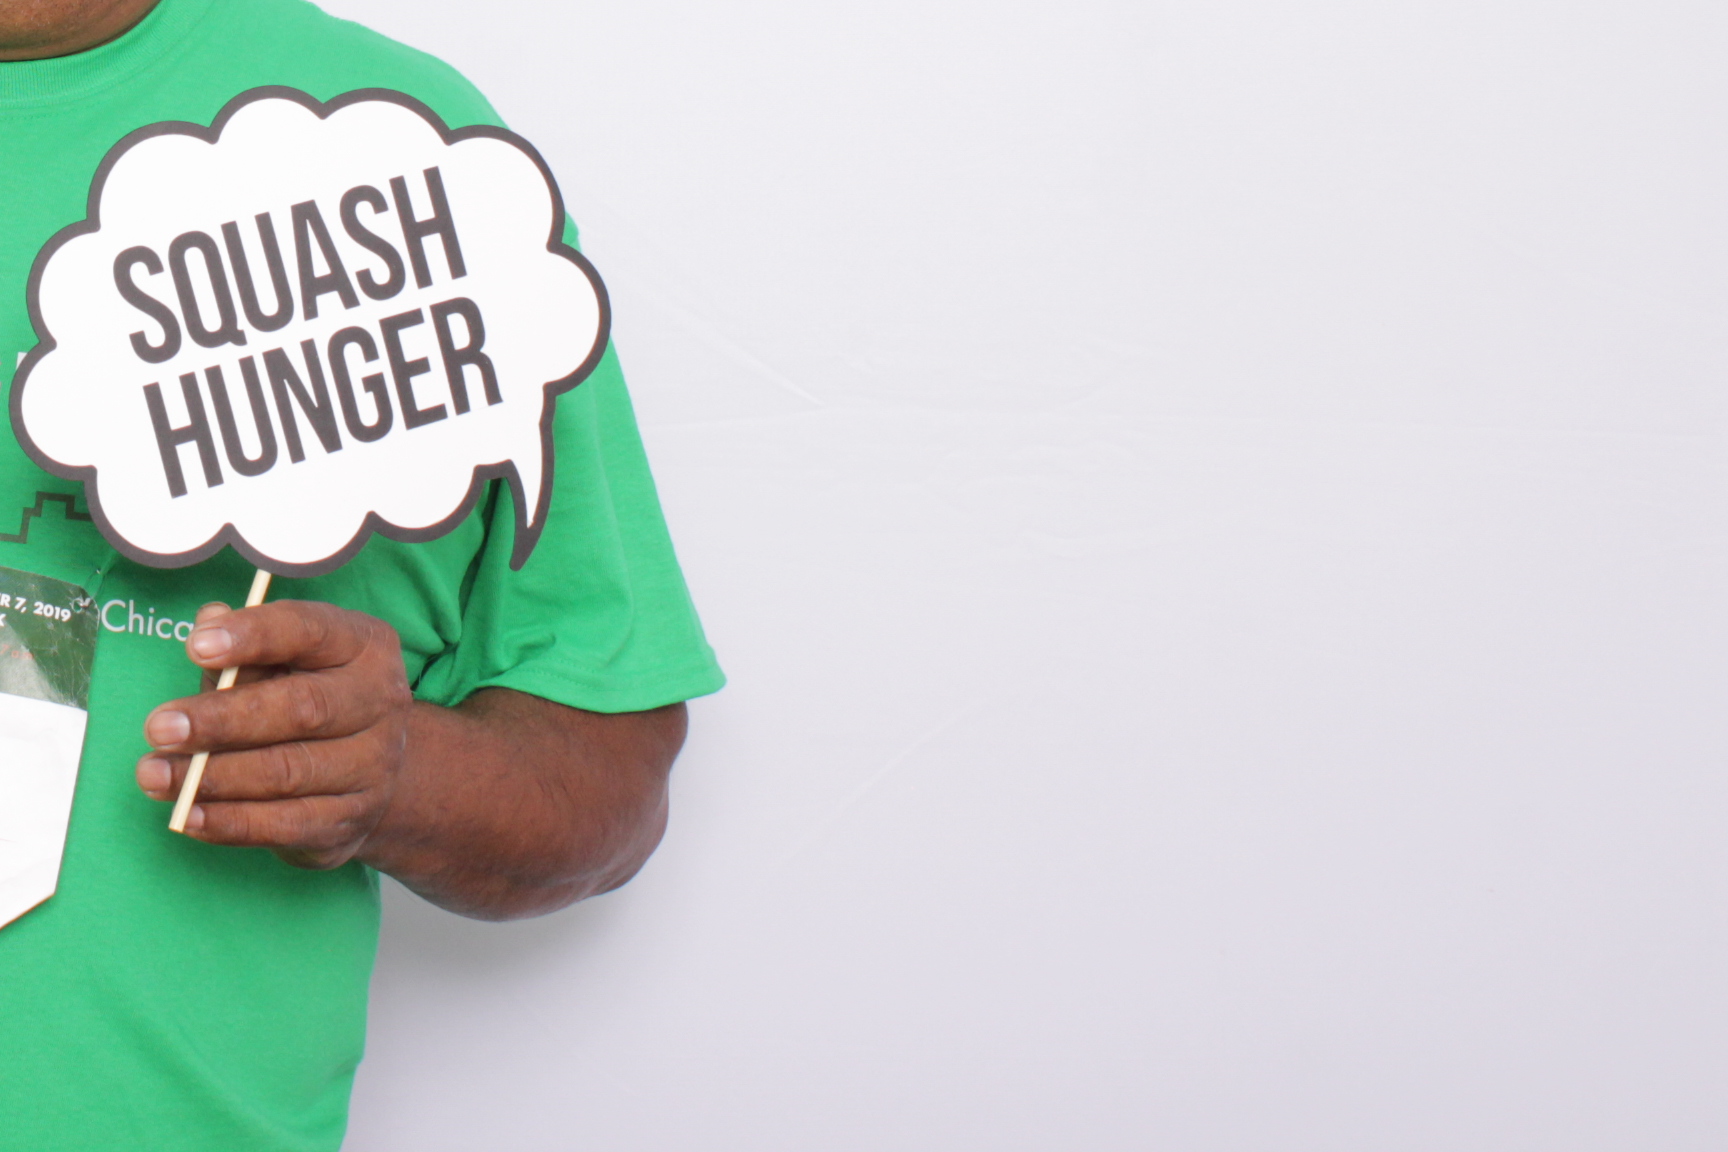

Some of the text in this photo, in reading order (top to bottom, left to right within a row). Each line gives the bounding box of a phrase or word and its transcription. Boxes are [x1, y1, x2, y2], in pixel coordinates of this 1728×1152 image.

[113, 165, 468, 365] SQUASH
[142, 296, 503, 499] HUNGER
[14, 597, 27, 613] 7,
[33, 601, 72, 622] 2019
[101, 599, 194, 642] Chica
